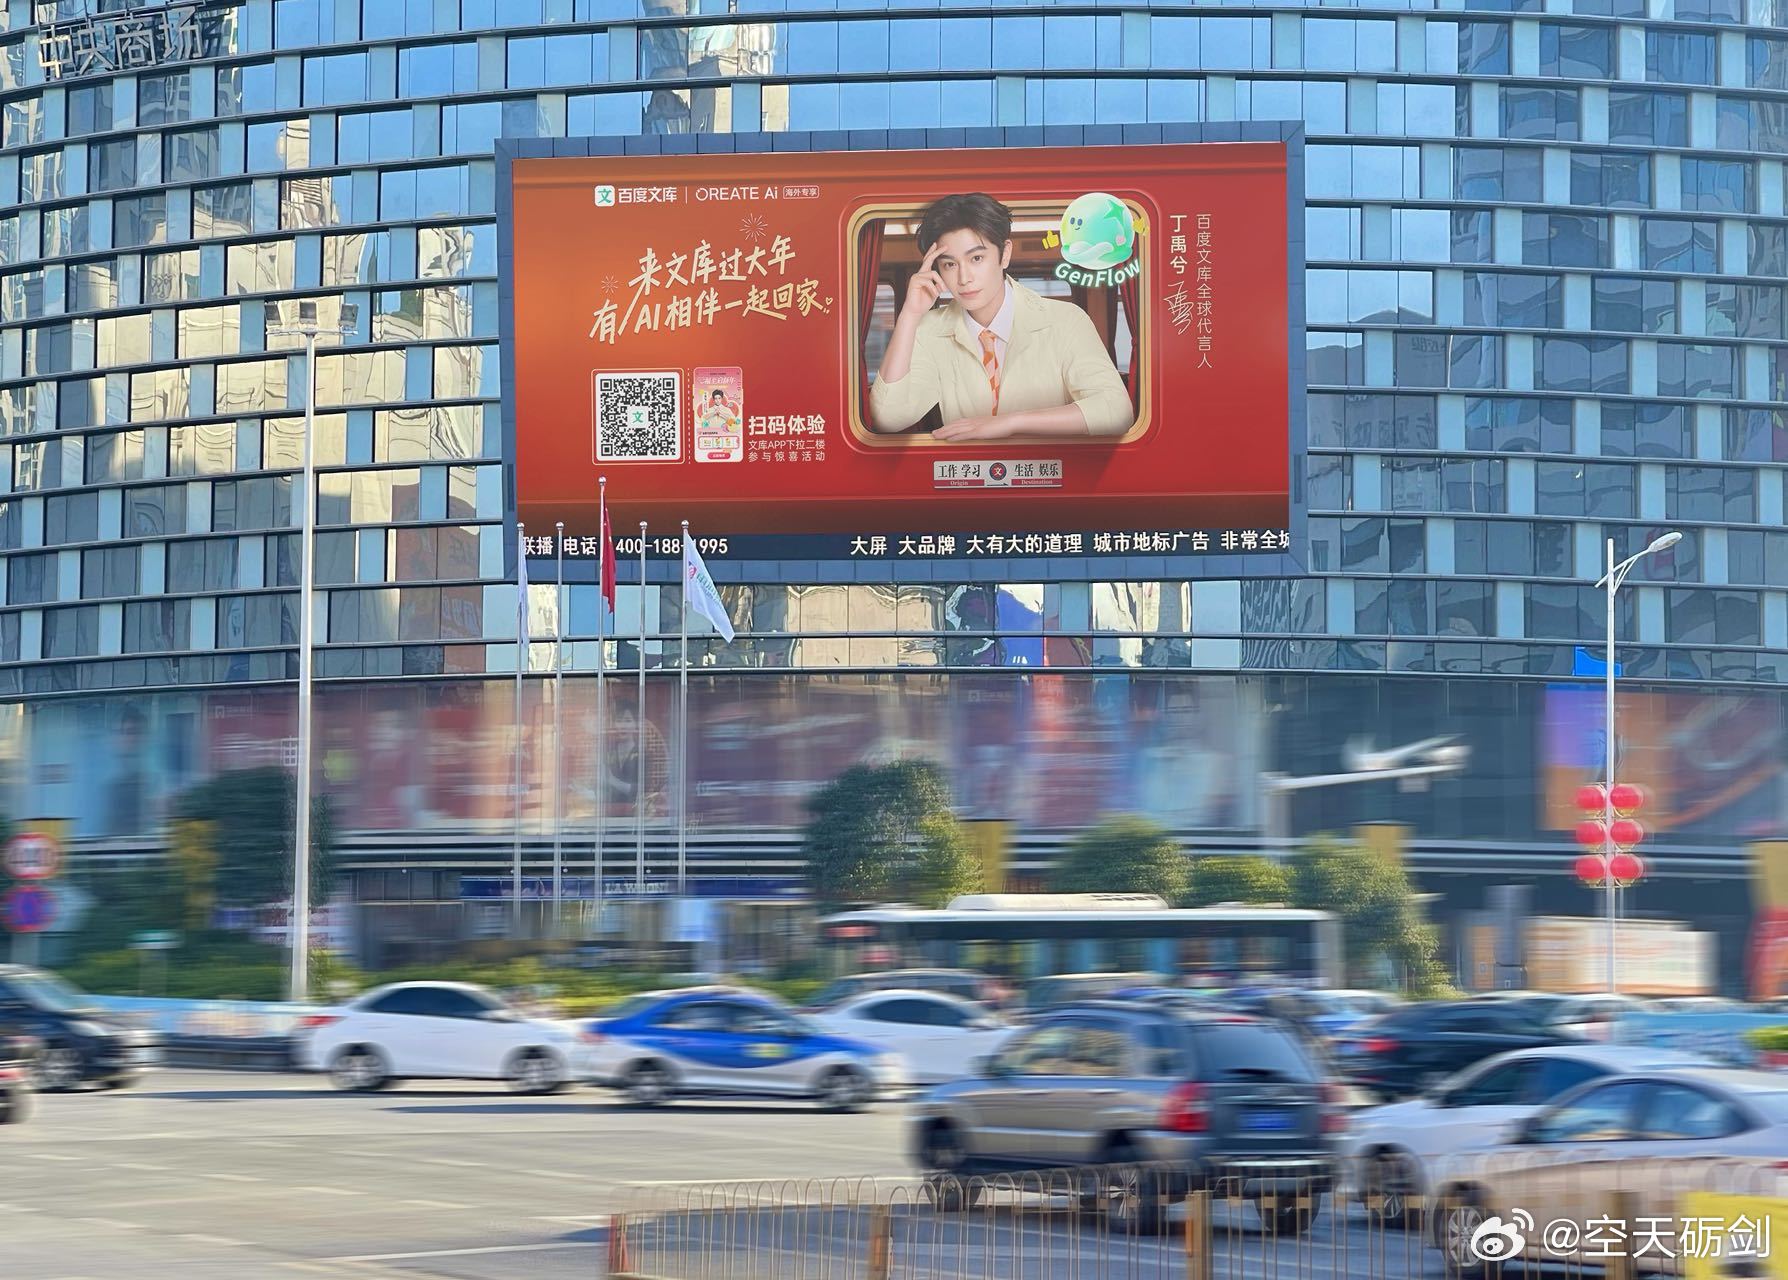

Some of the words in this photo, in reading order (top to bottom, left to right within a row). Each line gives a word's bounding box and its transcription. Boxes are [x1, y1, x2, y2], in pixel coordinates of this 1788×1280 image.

[39, 6, 203, 79] 中央商场
[618, 187, 677, 204] 百度文库
[1170, 214, 1188, 275] 丁禹兮
[628, 234, 796, 296] 来文库过大年
[1055, 259, 1140, 288] GenFlow
[1196, 213, 1213, 369] 百度文库全球代言人
[748, 414, 826, 436] 扫码体验
[748, 439, 826, 451] 文库APP下拉二楼
[938, 464, 958, 478] 工作
[961, 464, 981, 478] 学习
[1014, 463, 1034, 477] 生活
[1039, 463, 1059, 477] 娱乐
[563, 536, 598, 555] 电话
[615, 538, 728, 554] 400-188995
[850, 535, 887, 555] 大屏
[898, 535, 956, 556] 大品牌
[966, 533, 1082, 555] 大有大的道理
[1093, 531, 1209, 552] 城市地标广告
